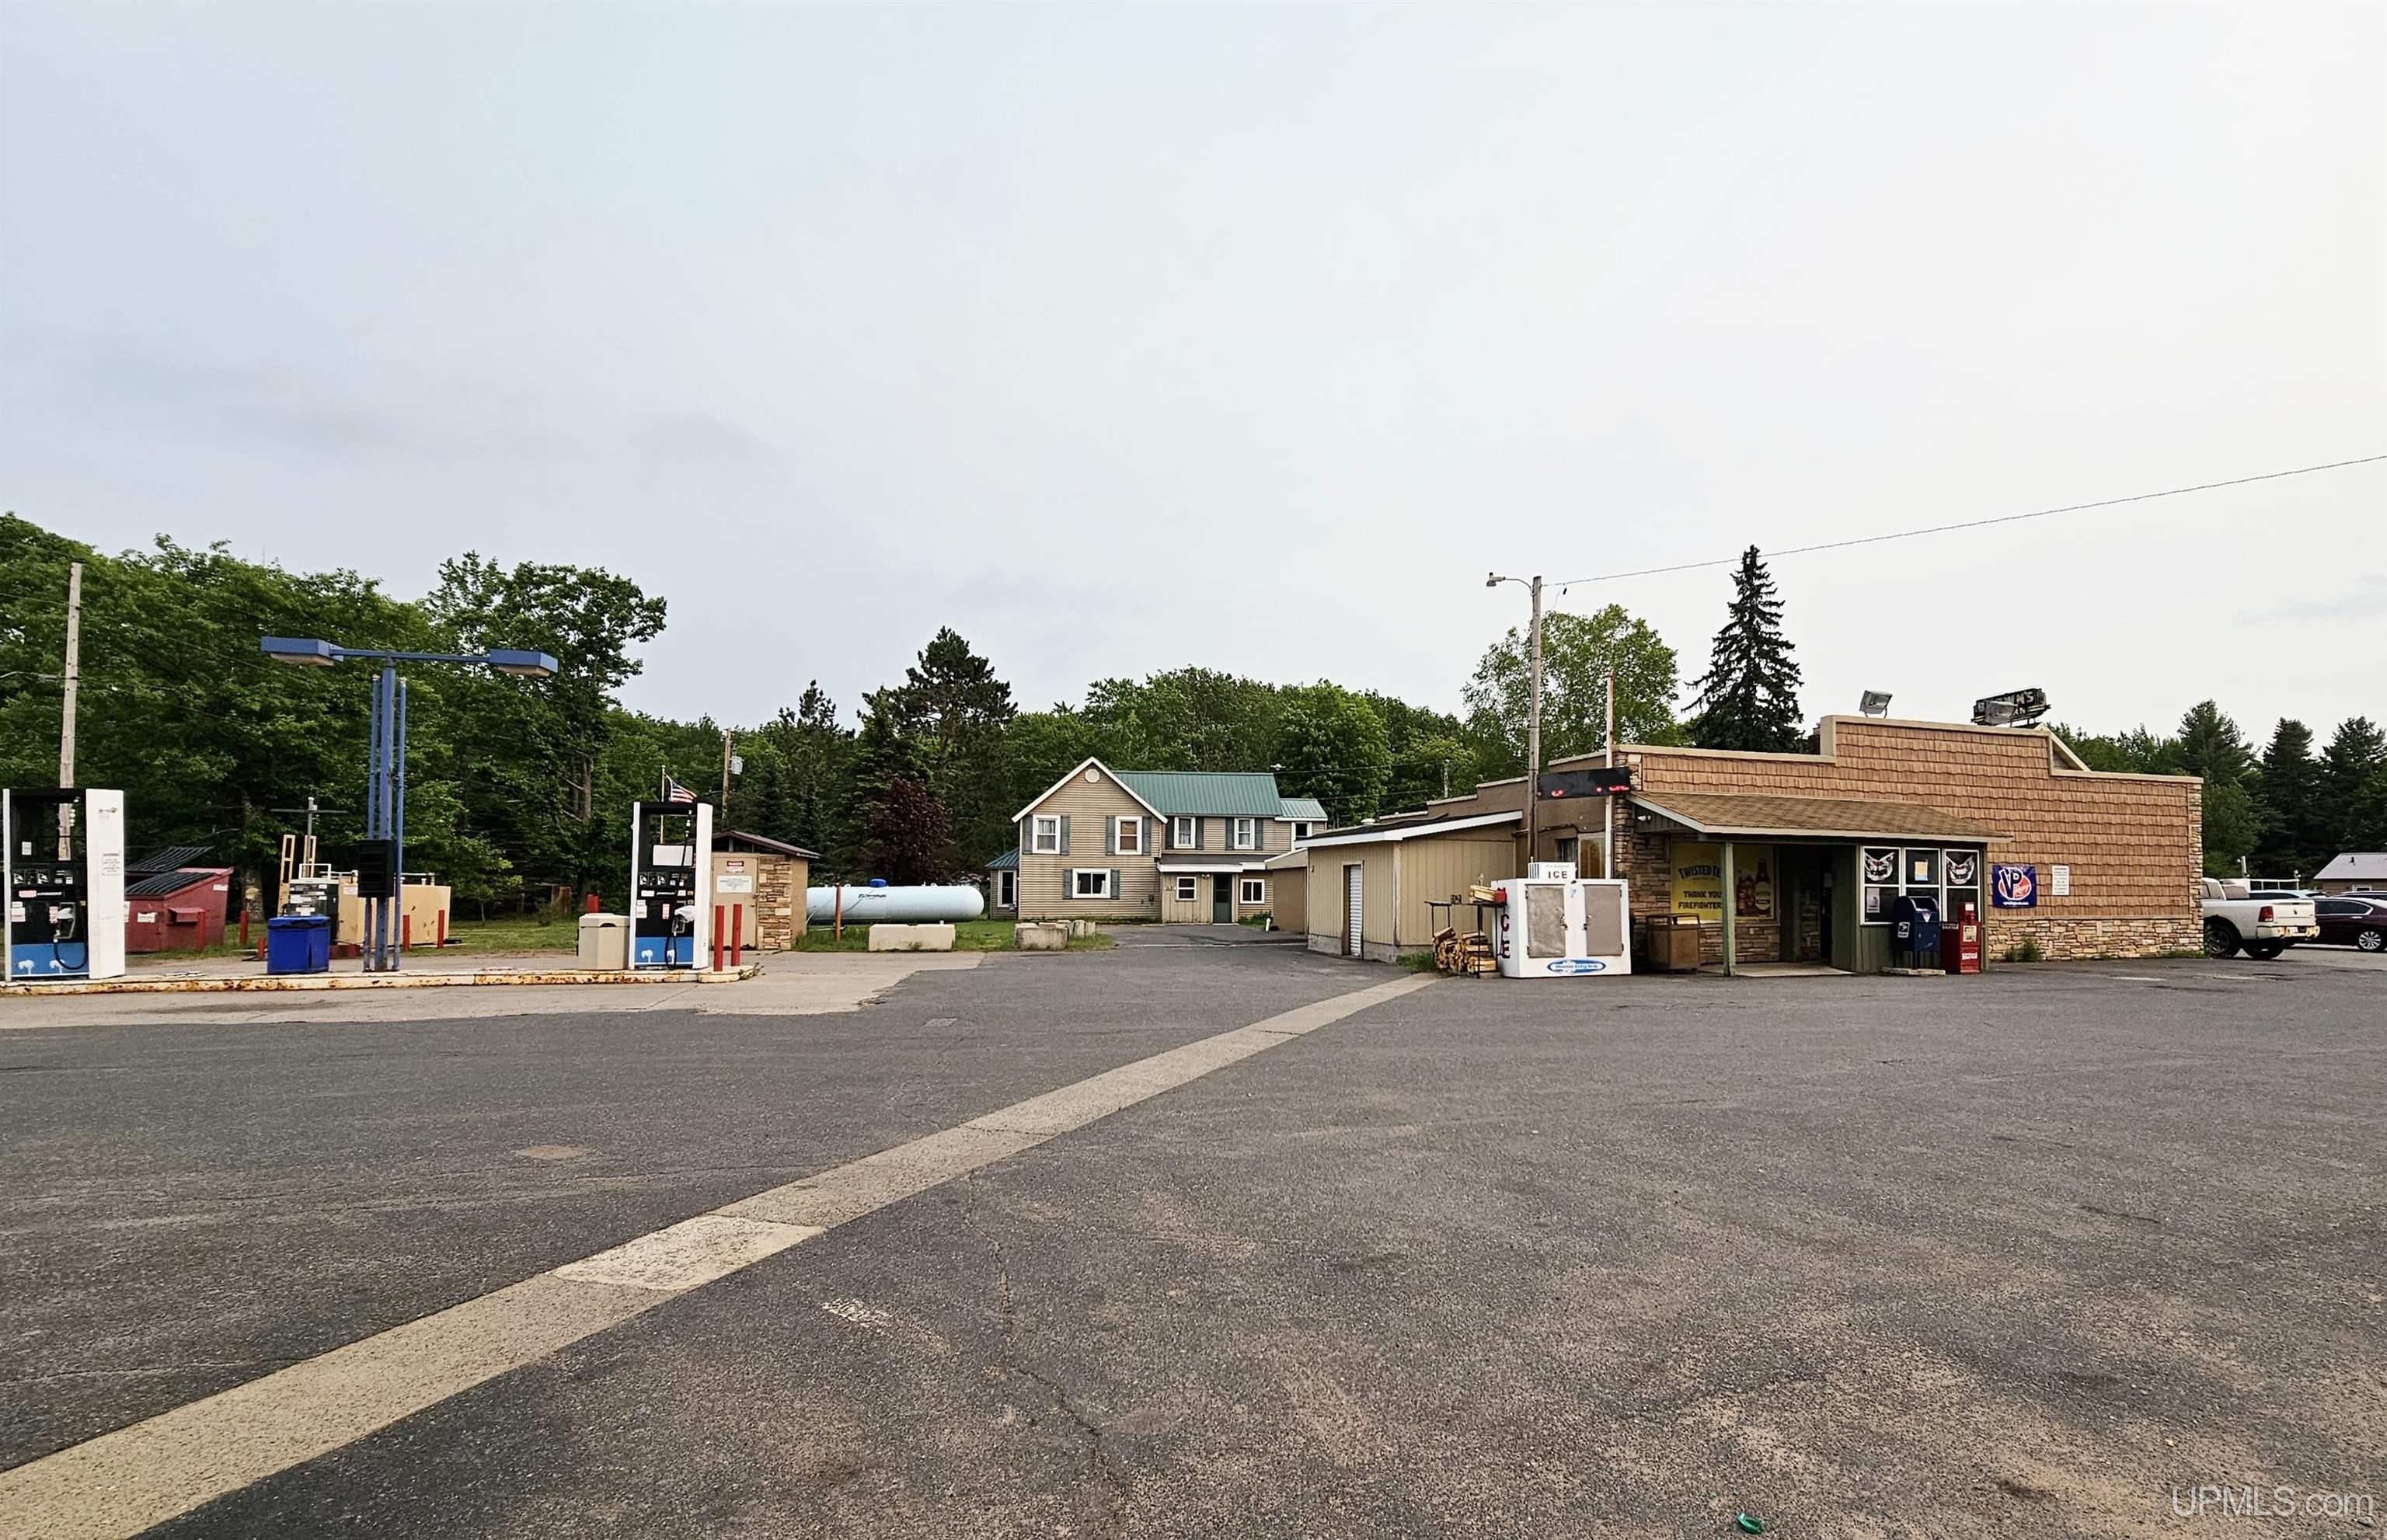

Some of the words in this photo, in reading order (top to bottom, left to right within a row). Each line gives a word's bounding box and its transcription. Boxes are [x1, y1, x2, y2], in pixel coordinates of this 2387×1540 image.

[1548, 870, 1567, 879] ICE
[1678, 865, 1712, 880] TWISTED
[1999, 866, 2023, 900] VP
